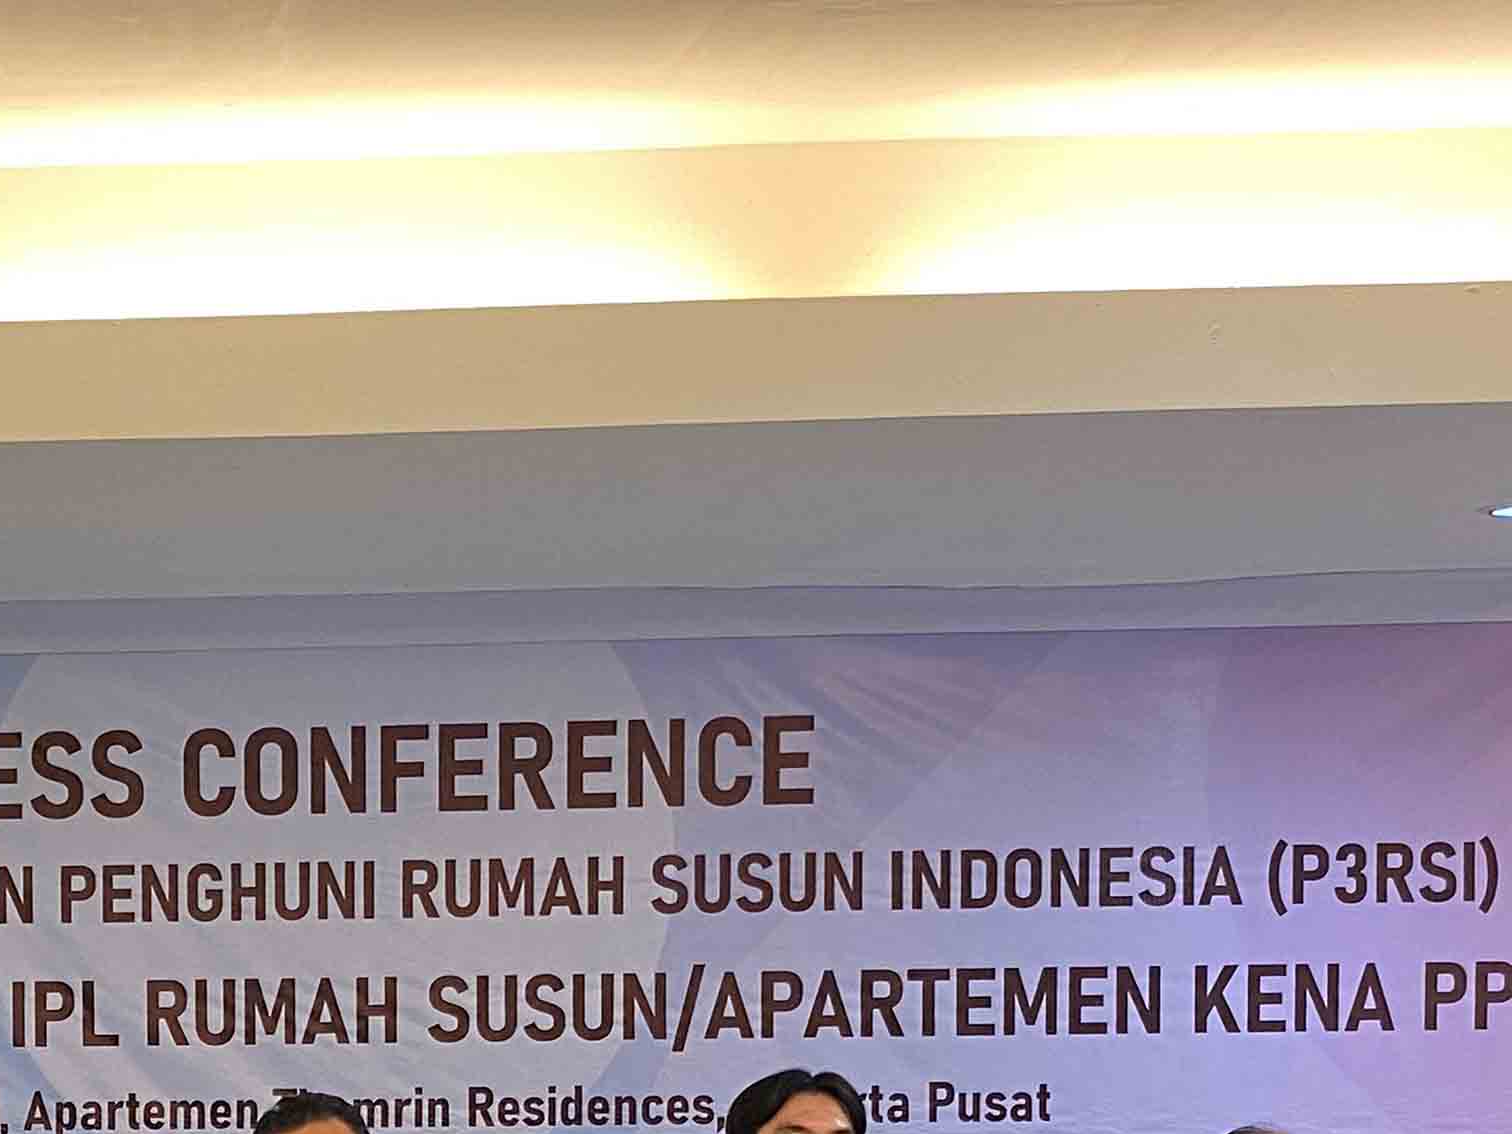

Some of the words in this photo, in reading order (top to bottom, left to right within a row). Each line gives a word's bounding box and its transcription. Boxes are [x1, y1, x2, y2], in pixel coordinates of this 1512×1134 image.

[183, 714, 815, 817] CONFERENCE
[60, 860, 375, 924] PENGHUNI
[402, 855, 625, 919] RUMAH
[651, 850, 864, 915] SUSUN
[891, 845, 1243, 911] INDONESIA
[1268, 835, 1499, 917] (P3RSI)
[11, 979, 120, 1048] IPL
[146, 976, 398, 1047] RUMAH
[427, 963, 1161, 1053] SUSUN/APARTEMEN
[1194, 962, 1395, 1034] KENA
[468, 1084, 726, 1134] Residences,
[928, 1081, 1051, 1123] Pusat
